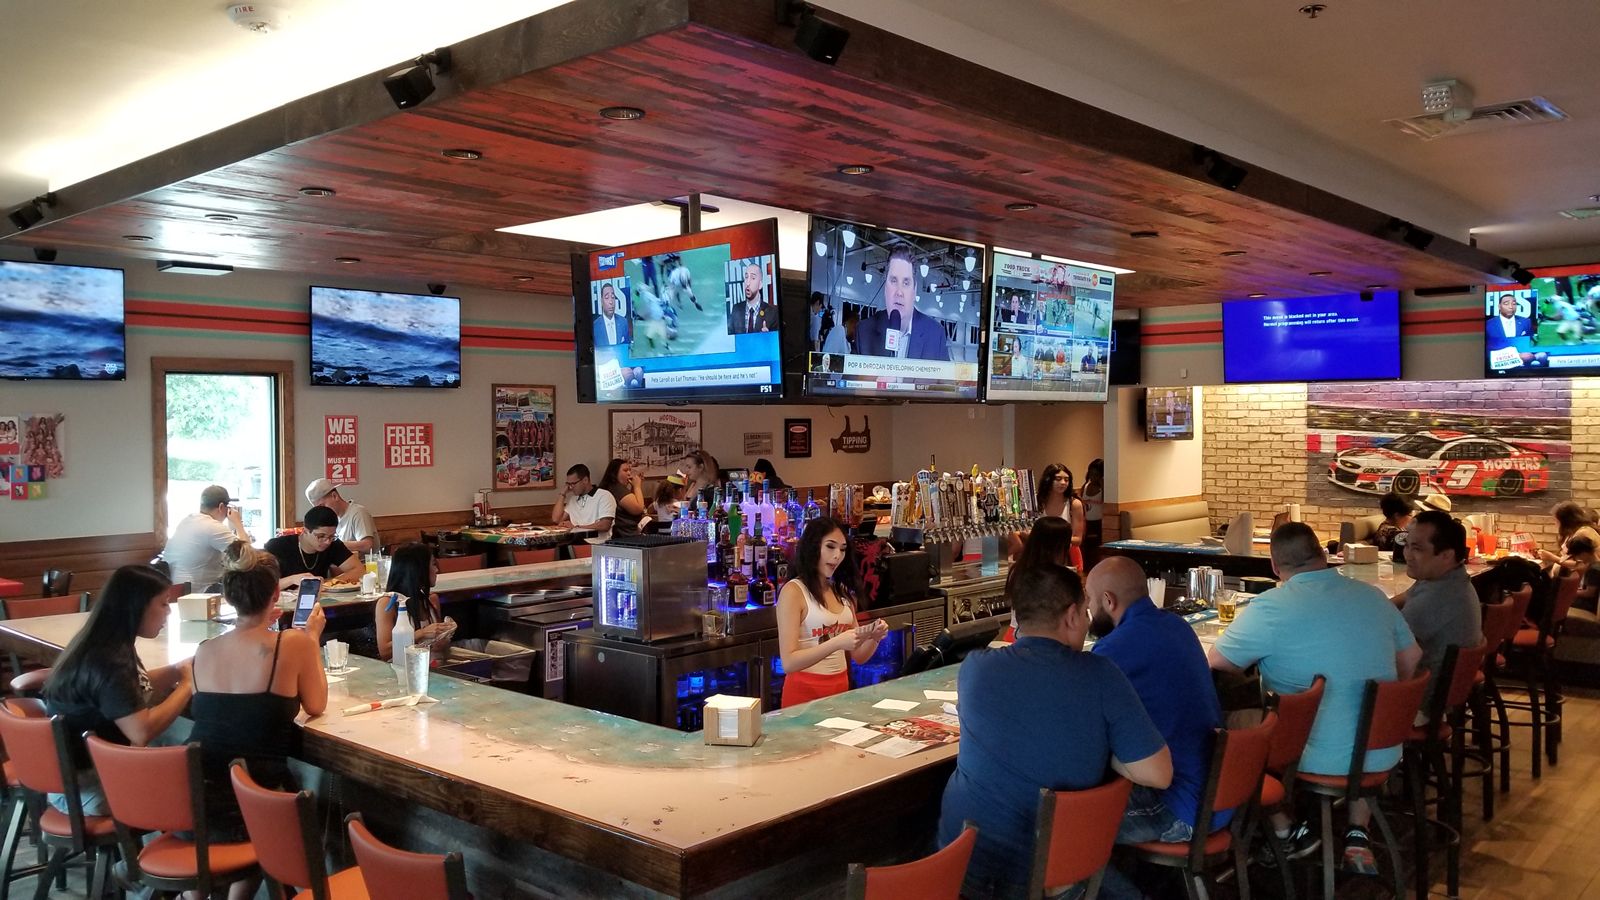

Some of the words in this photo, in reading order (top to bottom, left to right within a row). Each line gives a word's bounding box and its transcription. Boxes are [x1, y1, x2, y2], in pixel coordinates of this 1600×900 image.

[234, 5, 255, 13] FIRE
[328, 418, 354, 434] WE
[328, 434, 355, 444] CARD
[386, 426, 424, 445] FREE
[842, 436, 867, 444] TIPPING
[391, 446, 431, 466] BEER
[332, 464, 352, 478] 21
[1482, 458, 1540, 471] HOOTERS
[1446, 464, 1478, 489] 9
